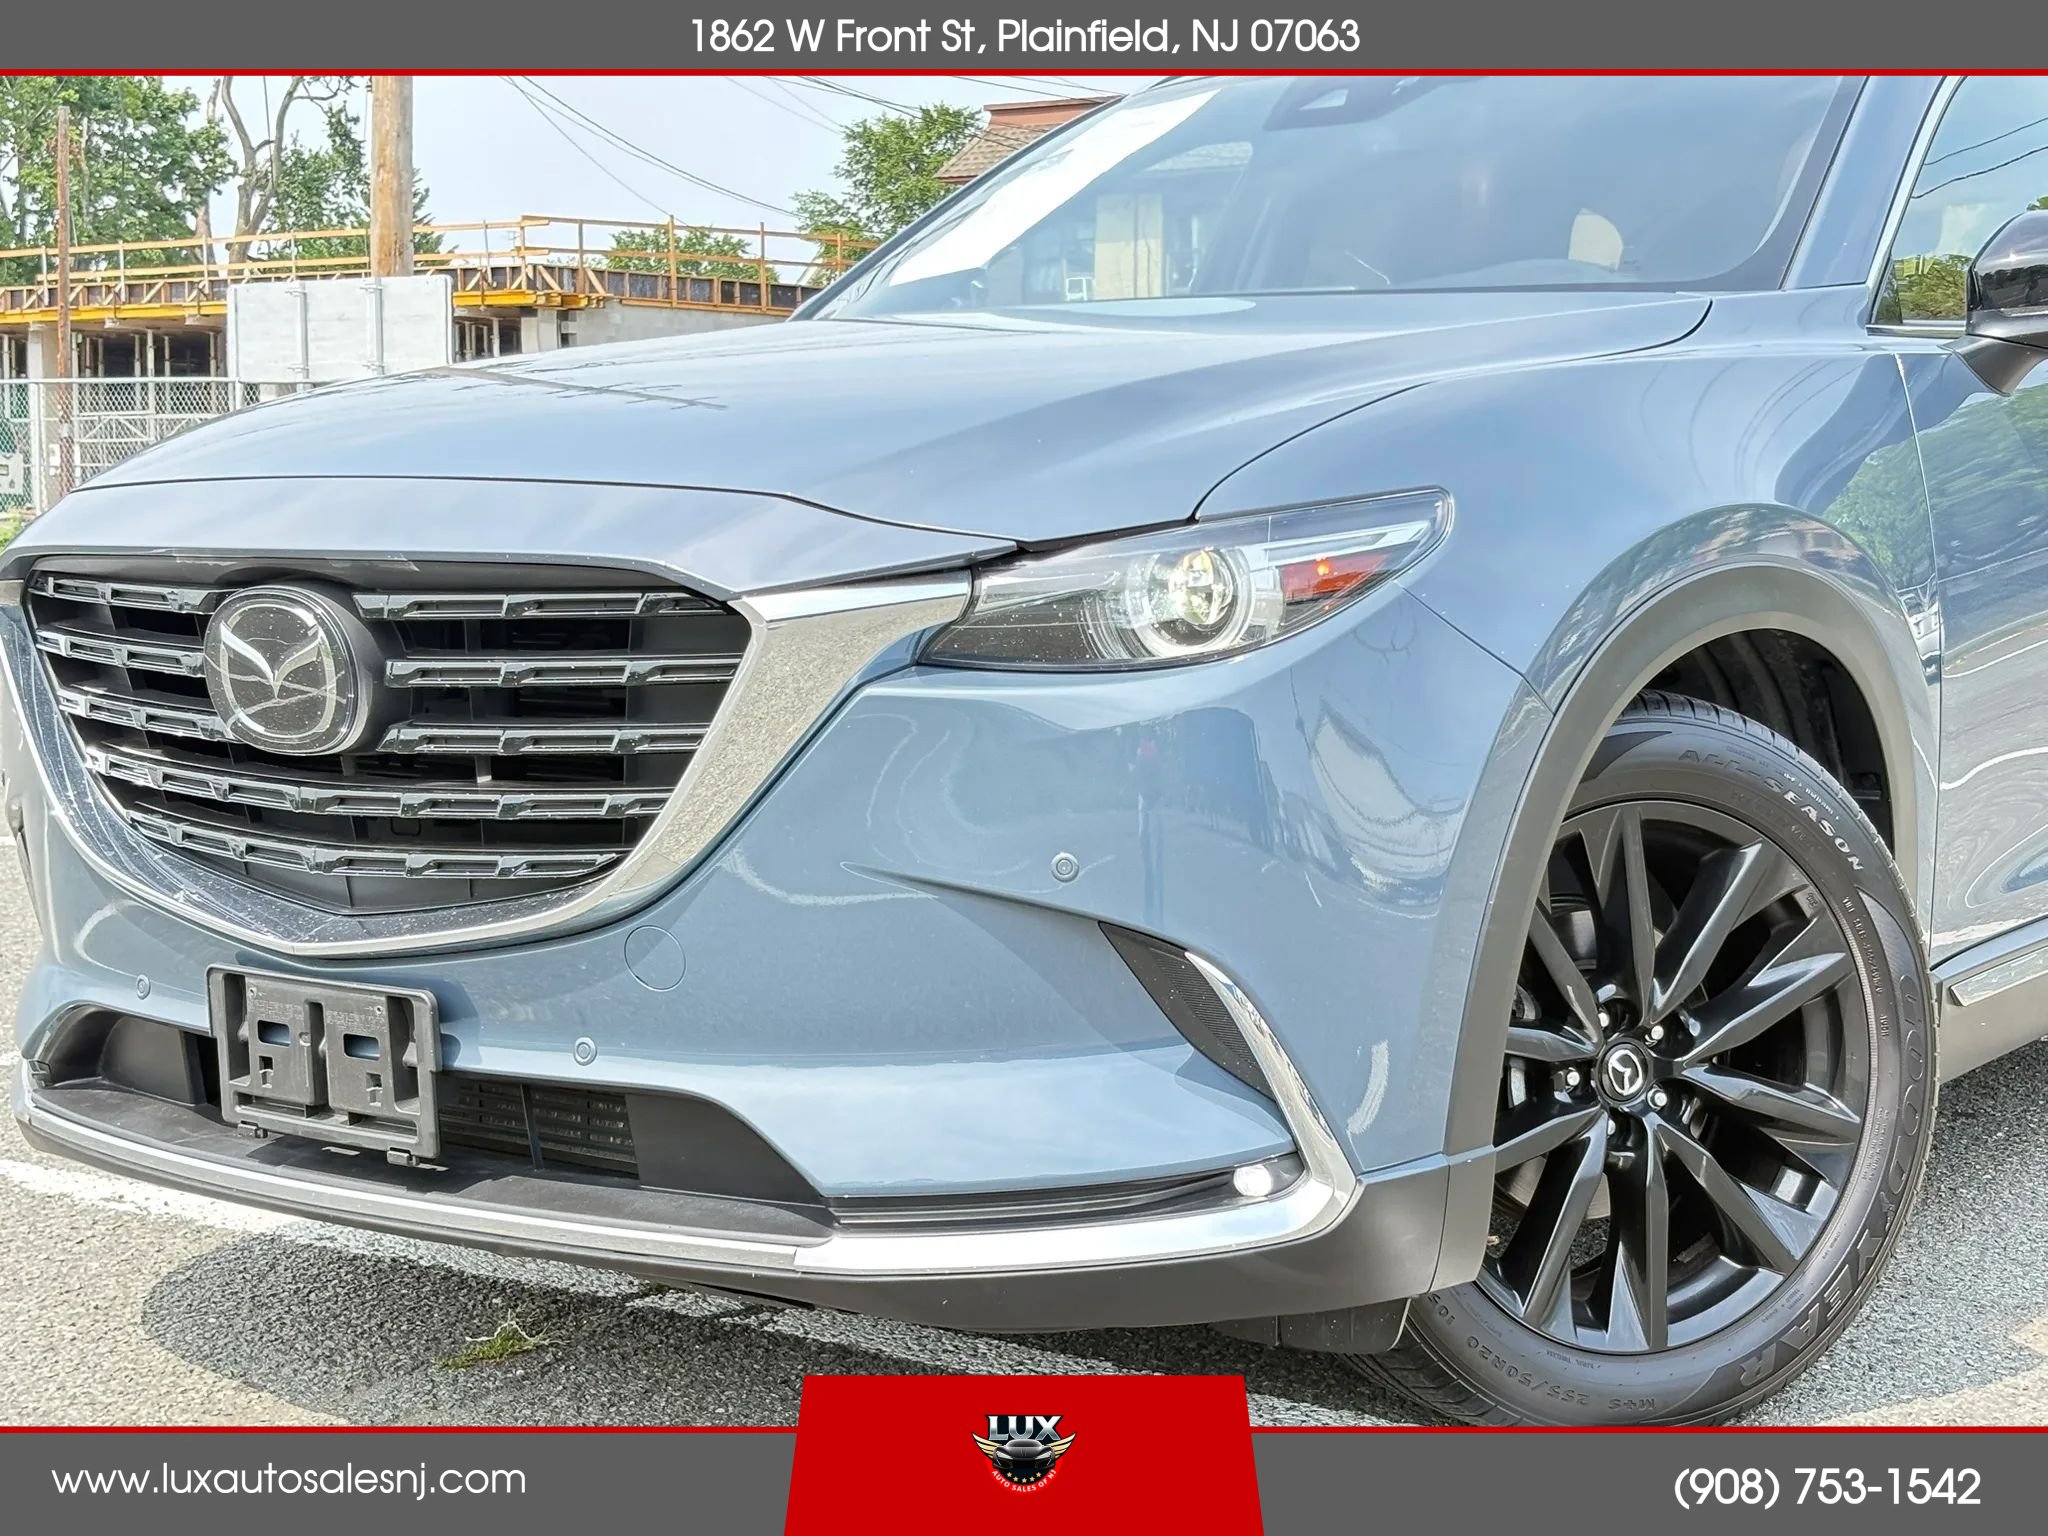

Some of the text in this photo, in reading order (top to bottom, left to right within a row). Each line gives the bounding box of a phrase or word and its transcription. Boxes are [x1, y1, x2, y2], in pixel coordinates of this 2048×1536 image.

[1678, 749, 1864, 872] ALL-SEASON
[1466, 1334, 1591, 1405] 255/50R20
[1607, 1397, 1656, 1411] M+S
